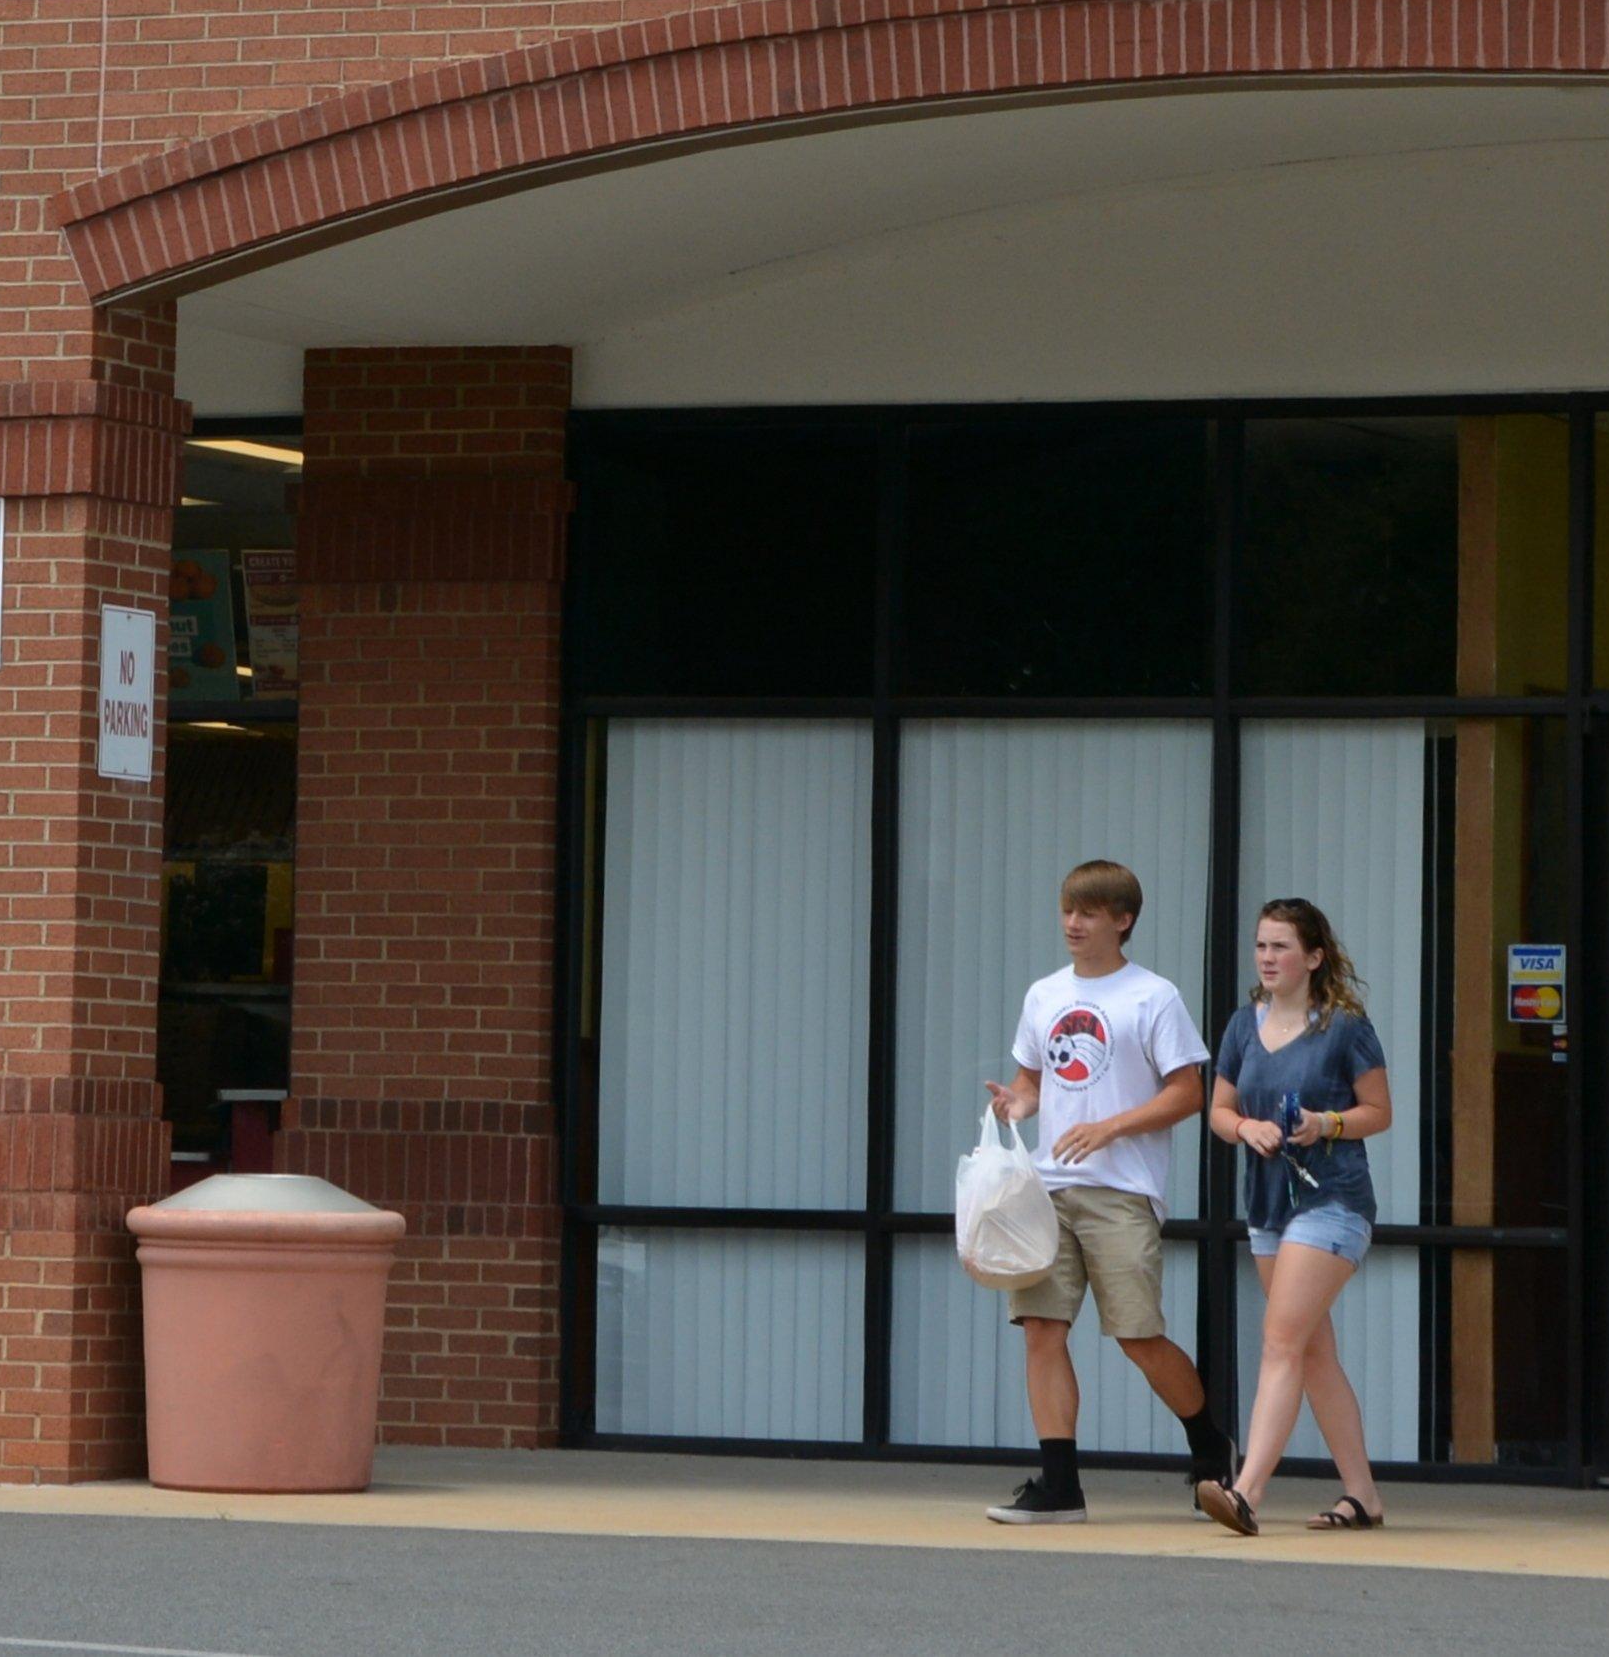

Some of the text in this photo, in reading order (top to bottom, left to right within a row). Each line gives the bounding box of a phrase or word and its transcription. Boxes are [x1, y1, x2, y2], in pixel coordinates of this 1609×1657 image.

[119, 650, 135, 685] NO
[104, 698, 148, 738] PARKING
[1520, 957, 1555, 970] VISA
